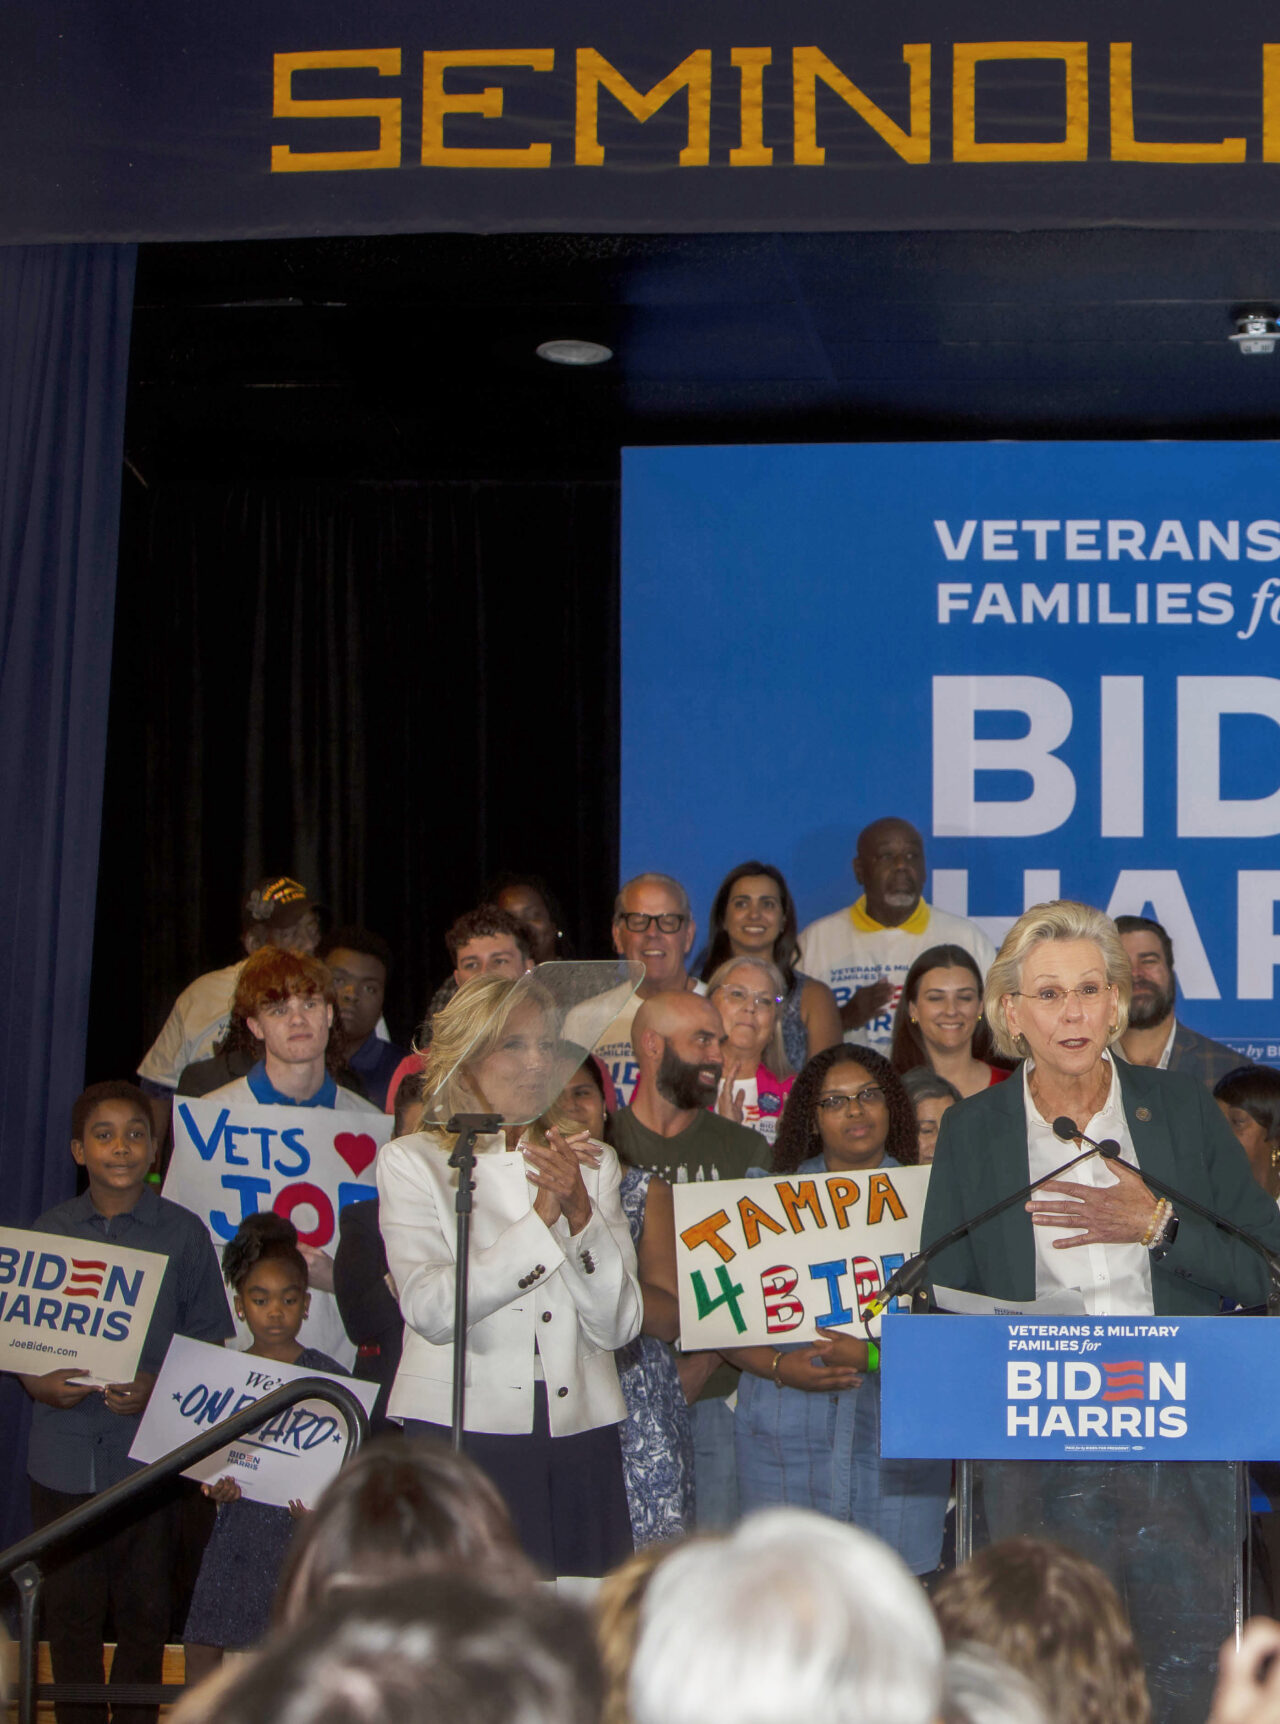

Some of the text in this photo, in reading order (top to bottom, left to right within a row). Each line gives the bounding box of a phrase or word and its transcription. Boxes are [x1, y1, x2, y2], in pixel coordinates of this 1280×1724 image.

[937, 582, 1235, 625] FAMILIES
[177, 1102, 311, 1178] VETS
[679, 1173, 908, 1264] TAMPA
[0, 1246, 145, 1308] BIDEN
[690, 1252, 914, 1335] 4 BIDE
[9, 1338, 78, 1358] JoeBiden.com
[1008, 1326, 1180, 1338] VETERANS & MILITARY
[1008, 1339, 1102, 1355] FAMILIES for
[1007, 1361, 1187, 1402] BIDEN
[180, 1384, 236, 1425] ON
[1007, 1406, 1188, 1439] HARRIS
[227, 1457, 259, 1470] HARRIS
[229, 1451, 260, 1465] BIDEN
